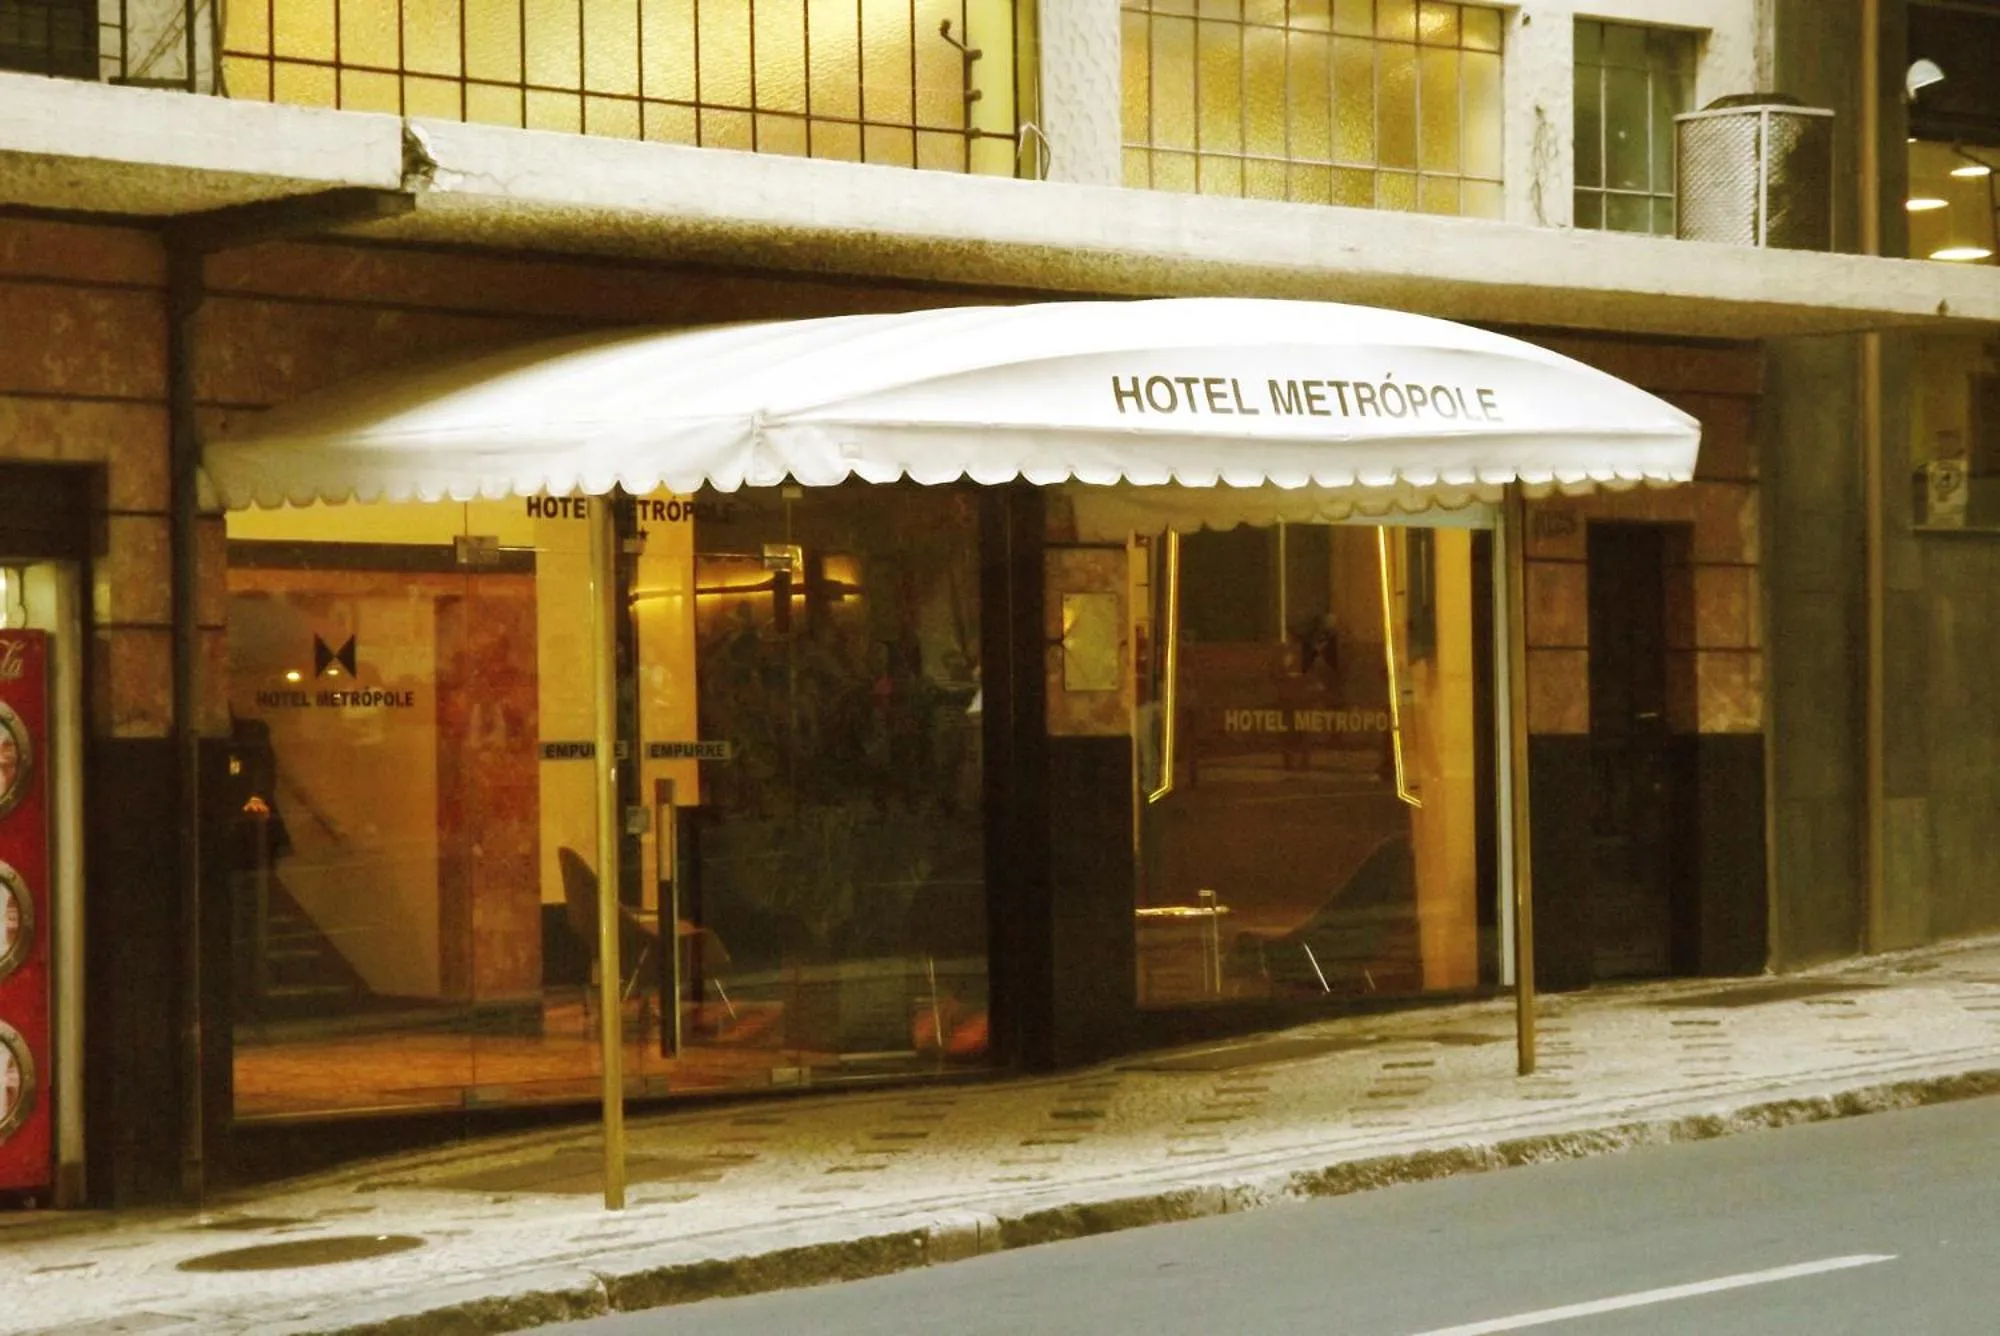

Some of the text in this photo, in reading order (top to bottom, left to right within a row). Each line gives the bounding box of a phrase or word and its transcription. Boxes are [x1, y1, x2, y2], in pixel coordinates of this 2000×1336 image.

[1111, 371, 1505, 423] HOTEL METRÓPOLE
[526, 496, 590, 520] HOTE
[256, 686, 415, 708] HOTEL METRÓPOLE
[1224, 706, 1392, 733] HOTEL METRÓPO
